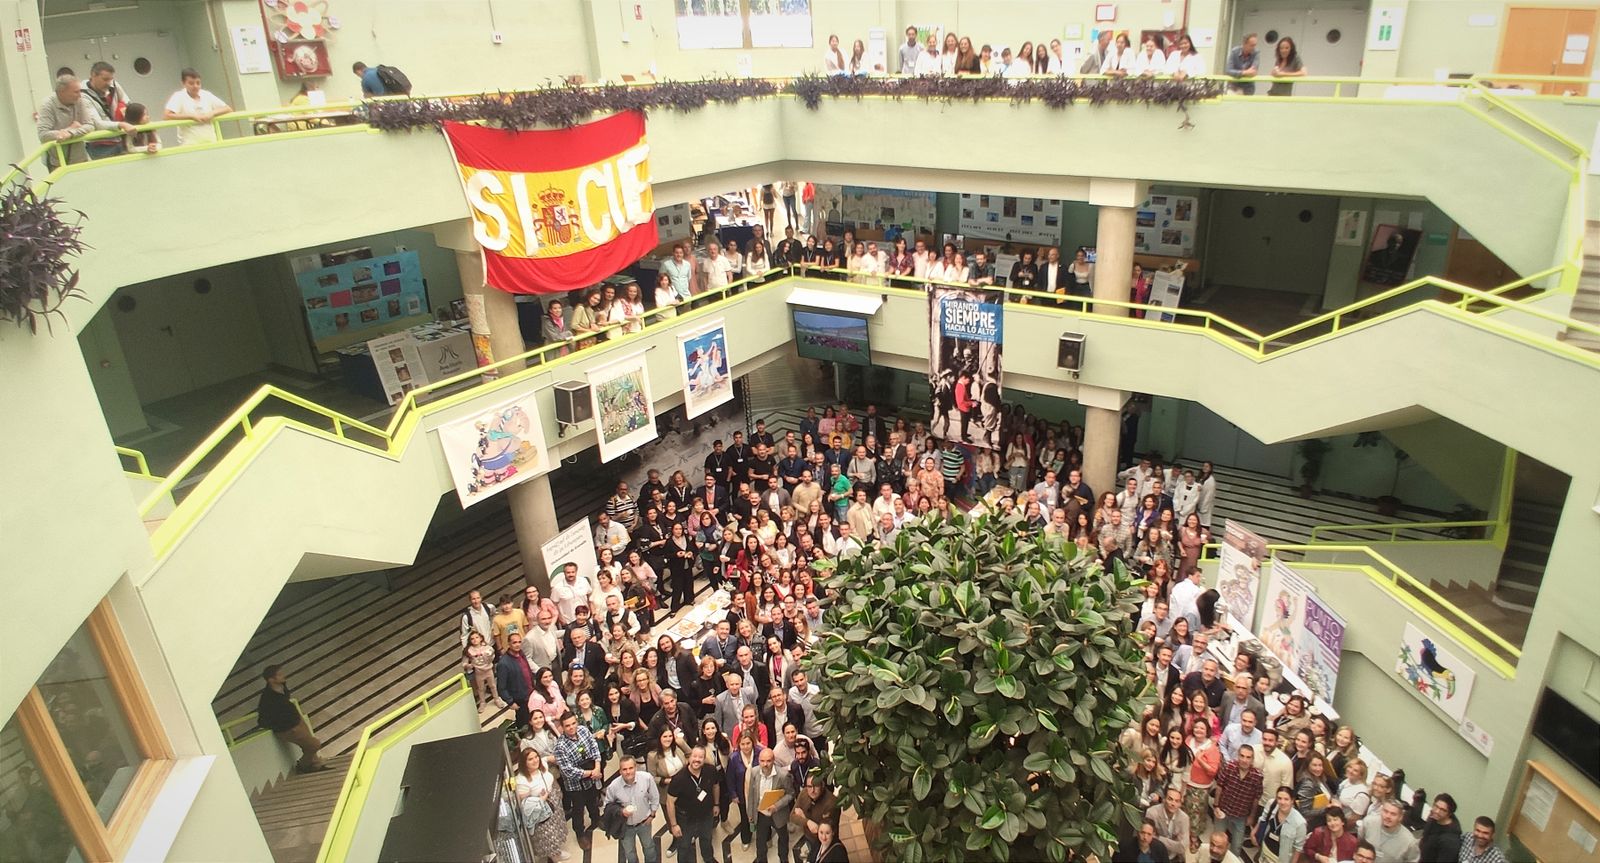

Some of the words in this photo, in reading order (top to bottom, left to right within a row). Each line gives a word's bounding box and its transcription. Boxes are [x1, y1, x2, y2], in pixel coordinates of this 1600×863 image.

[467, 169, 539, 257] SI
[945, 308, 995, 329] SIEMPRE
[945, 323, 966, 331] HACIA
[967, 325, 977, 334] LO
[1307, 600, 1341, 638] PUNTO
